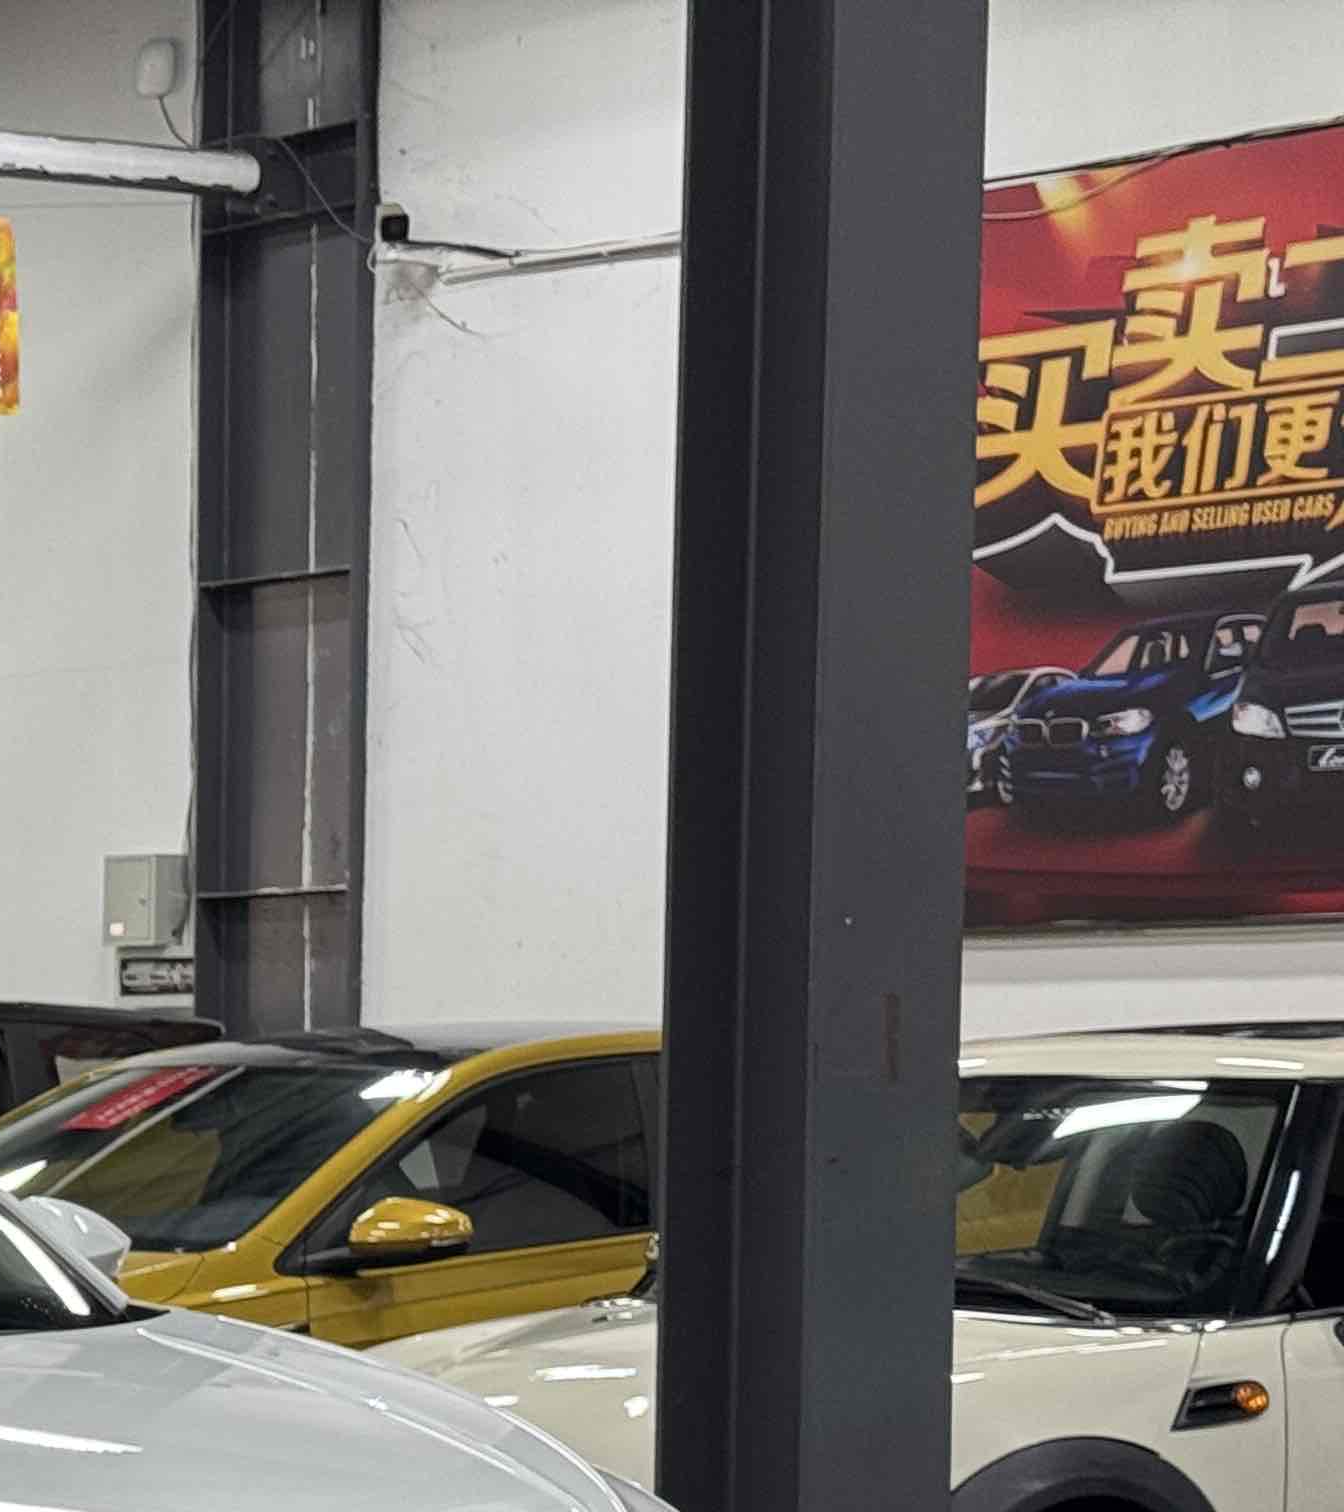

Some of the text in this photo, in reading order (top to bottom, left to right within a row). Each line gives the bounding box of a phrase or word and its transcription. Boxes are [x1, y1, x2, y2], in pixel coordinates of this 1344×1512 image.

[1104, 390, 1344, 500] 我们更
[1159, 509, 1190, 535] AND
[1191, 502, 1250, 531] SELLING
[1252, 498, 1292, 524] USED
[1292, 494, 1335, 520] CARS
